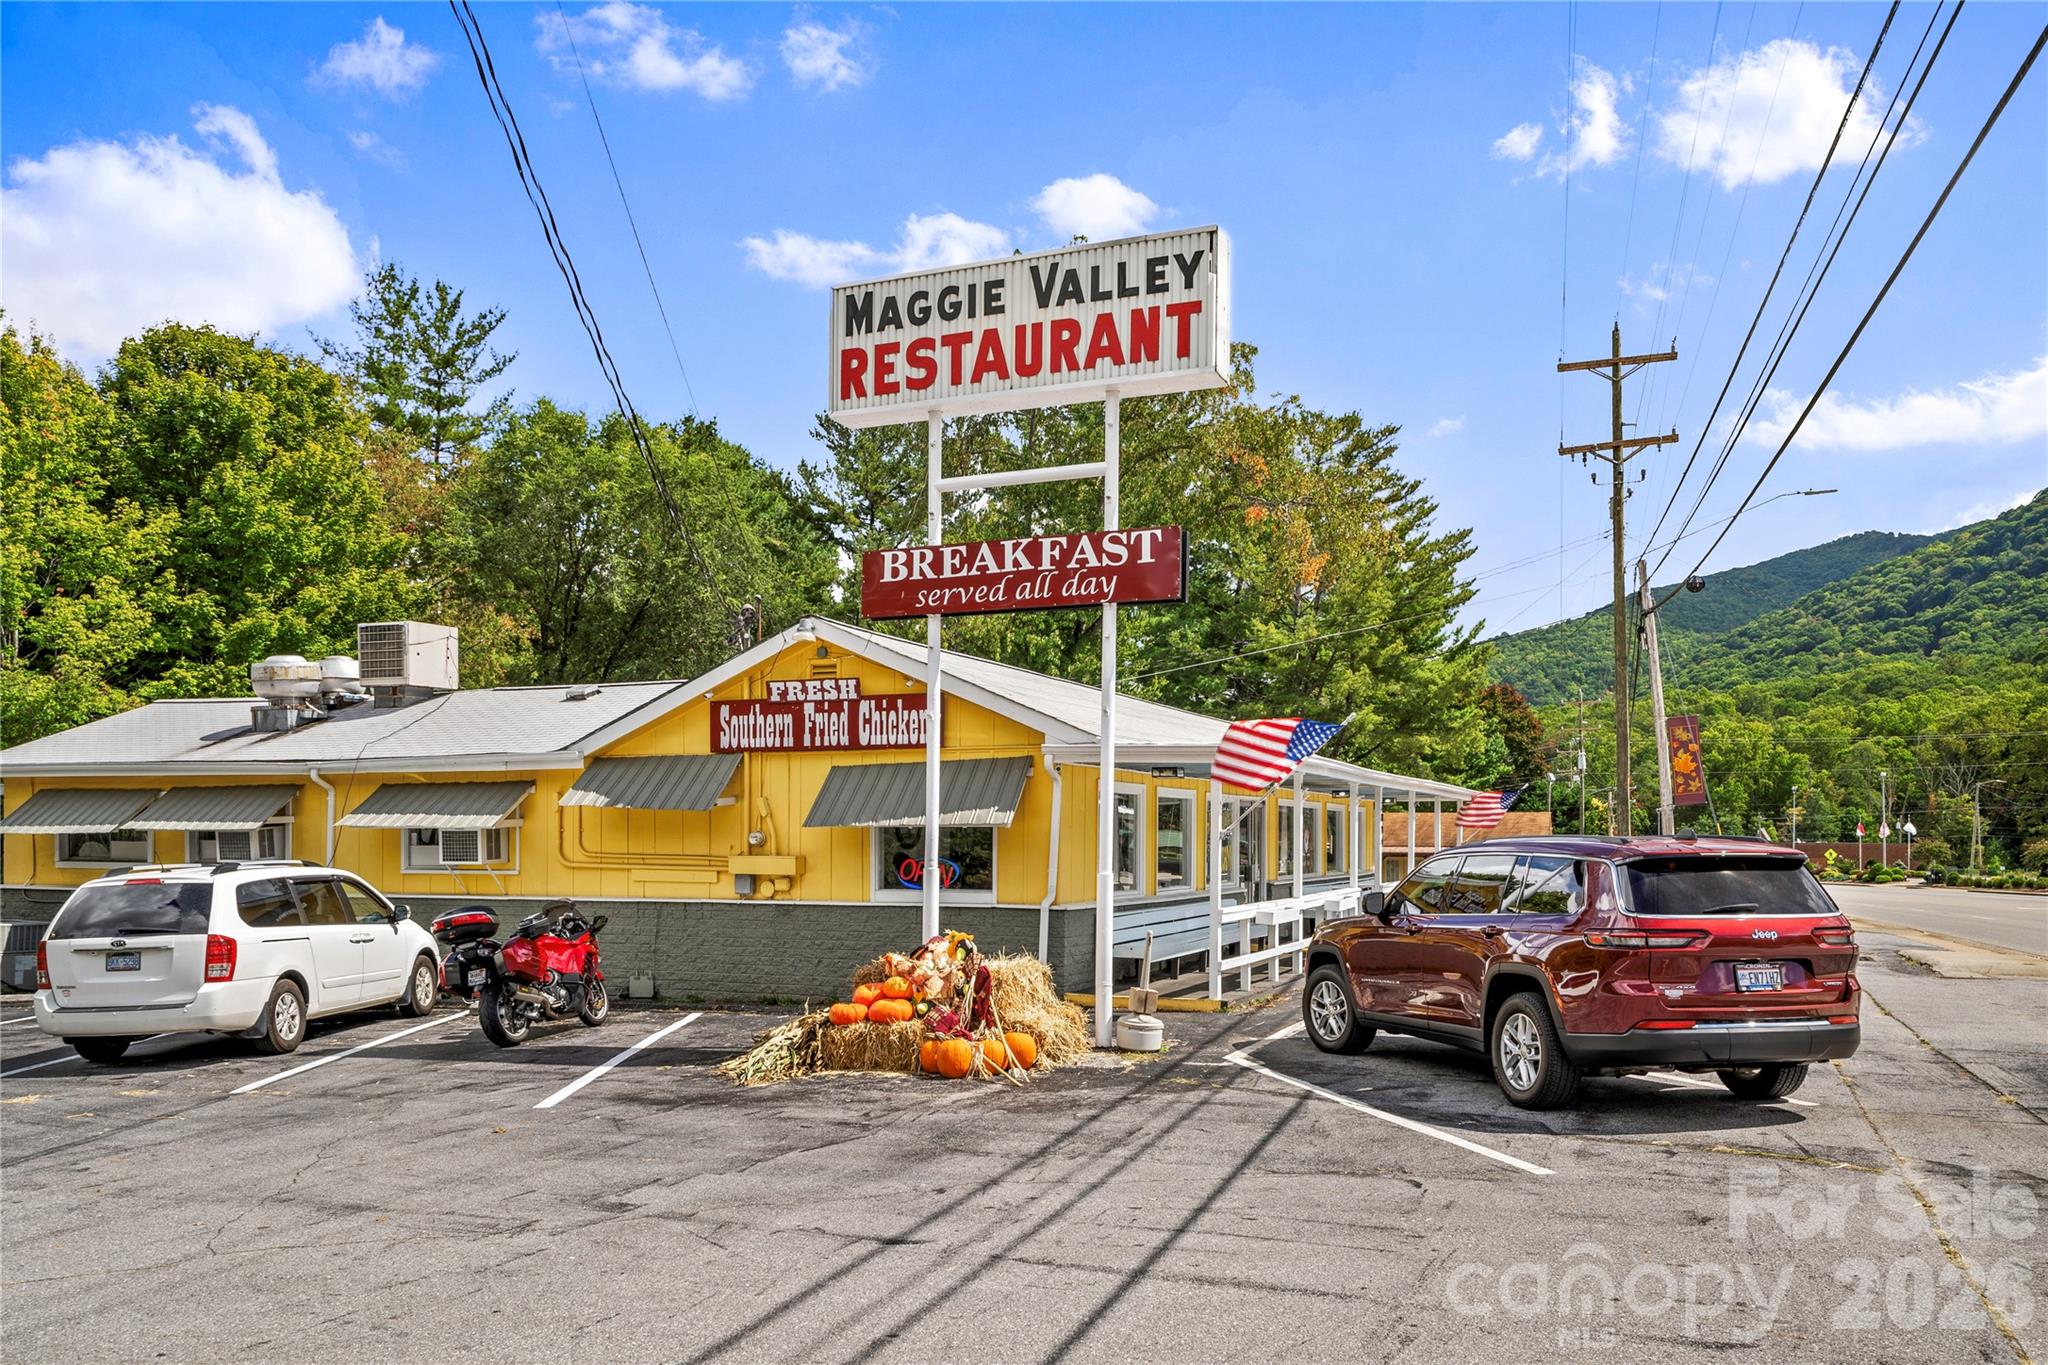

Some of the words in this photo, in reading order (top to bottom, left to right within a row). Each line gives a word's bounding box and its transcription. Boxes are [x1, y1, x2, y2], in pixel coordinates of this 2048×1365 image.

[845, 279, 1006, 337] MAGGIE
[1030, 250, 1205, 309] VALLEY
[840, 300, 1203, 401] RESTAURANT
[879, 528, 1163, 583] BREAKFAST
[915, 572, 1012, 608] served
[1015, 570, 1050, 600] all
[1061, 568, 1119, 603] day
[769, 679, 859, 702] FRESH
[720, 701, 794, 750] Southern
[803, 701, 849, 747] Fried
[900, 858, 954, 889] OPN
[1752, 929, 1778, 941] Jeep
